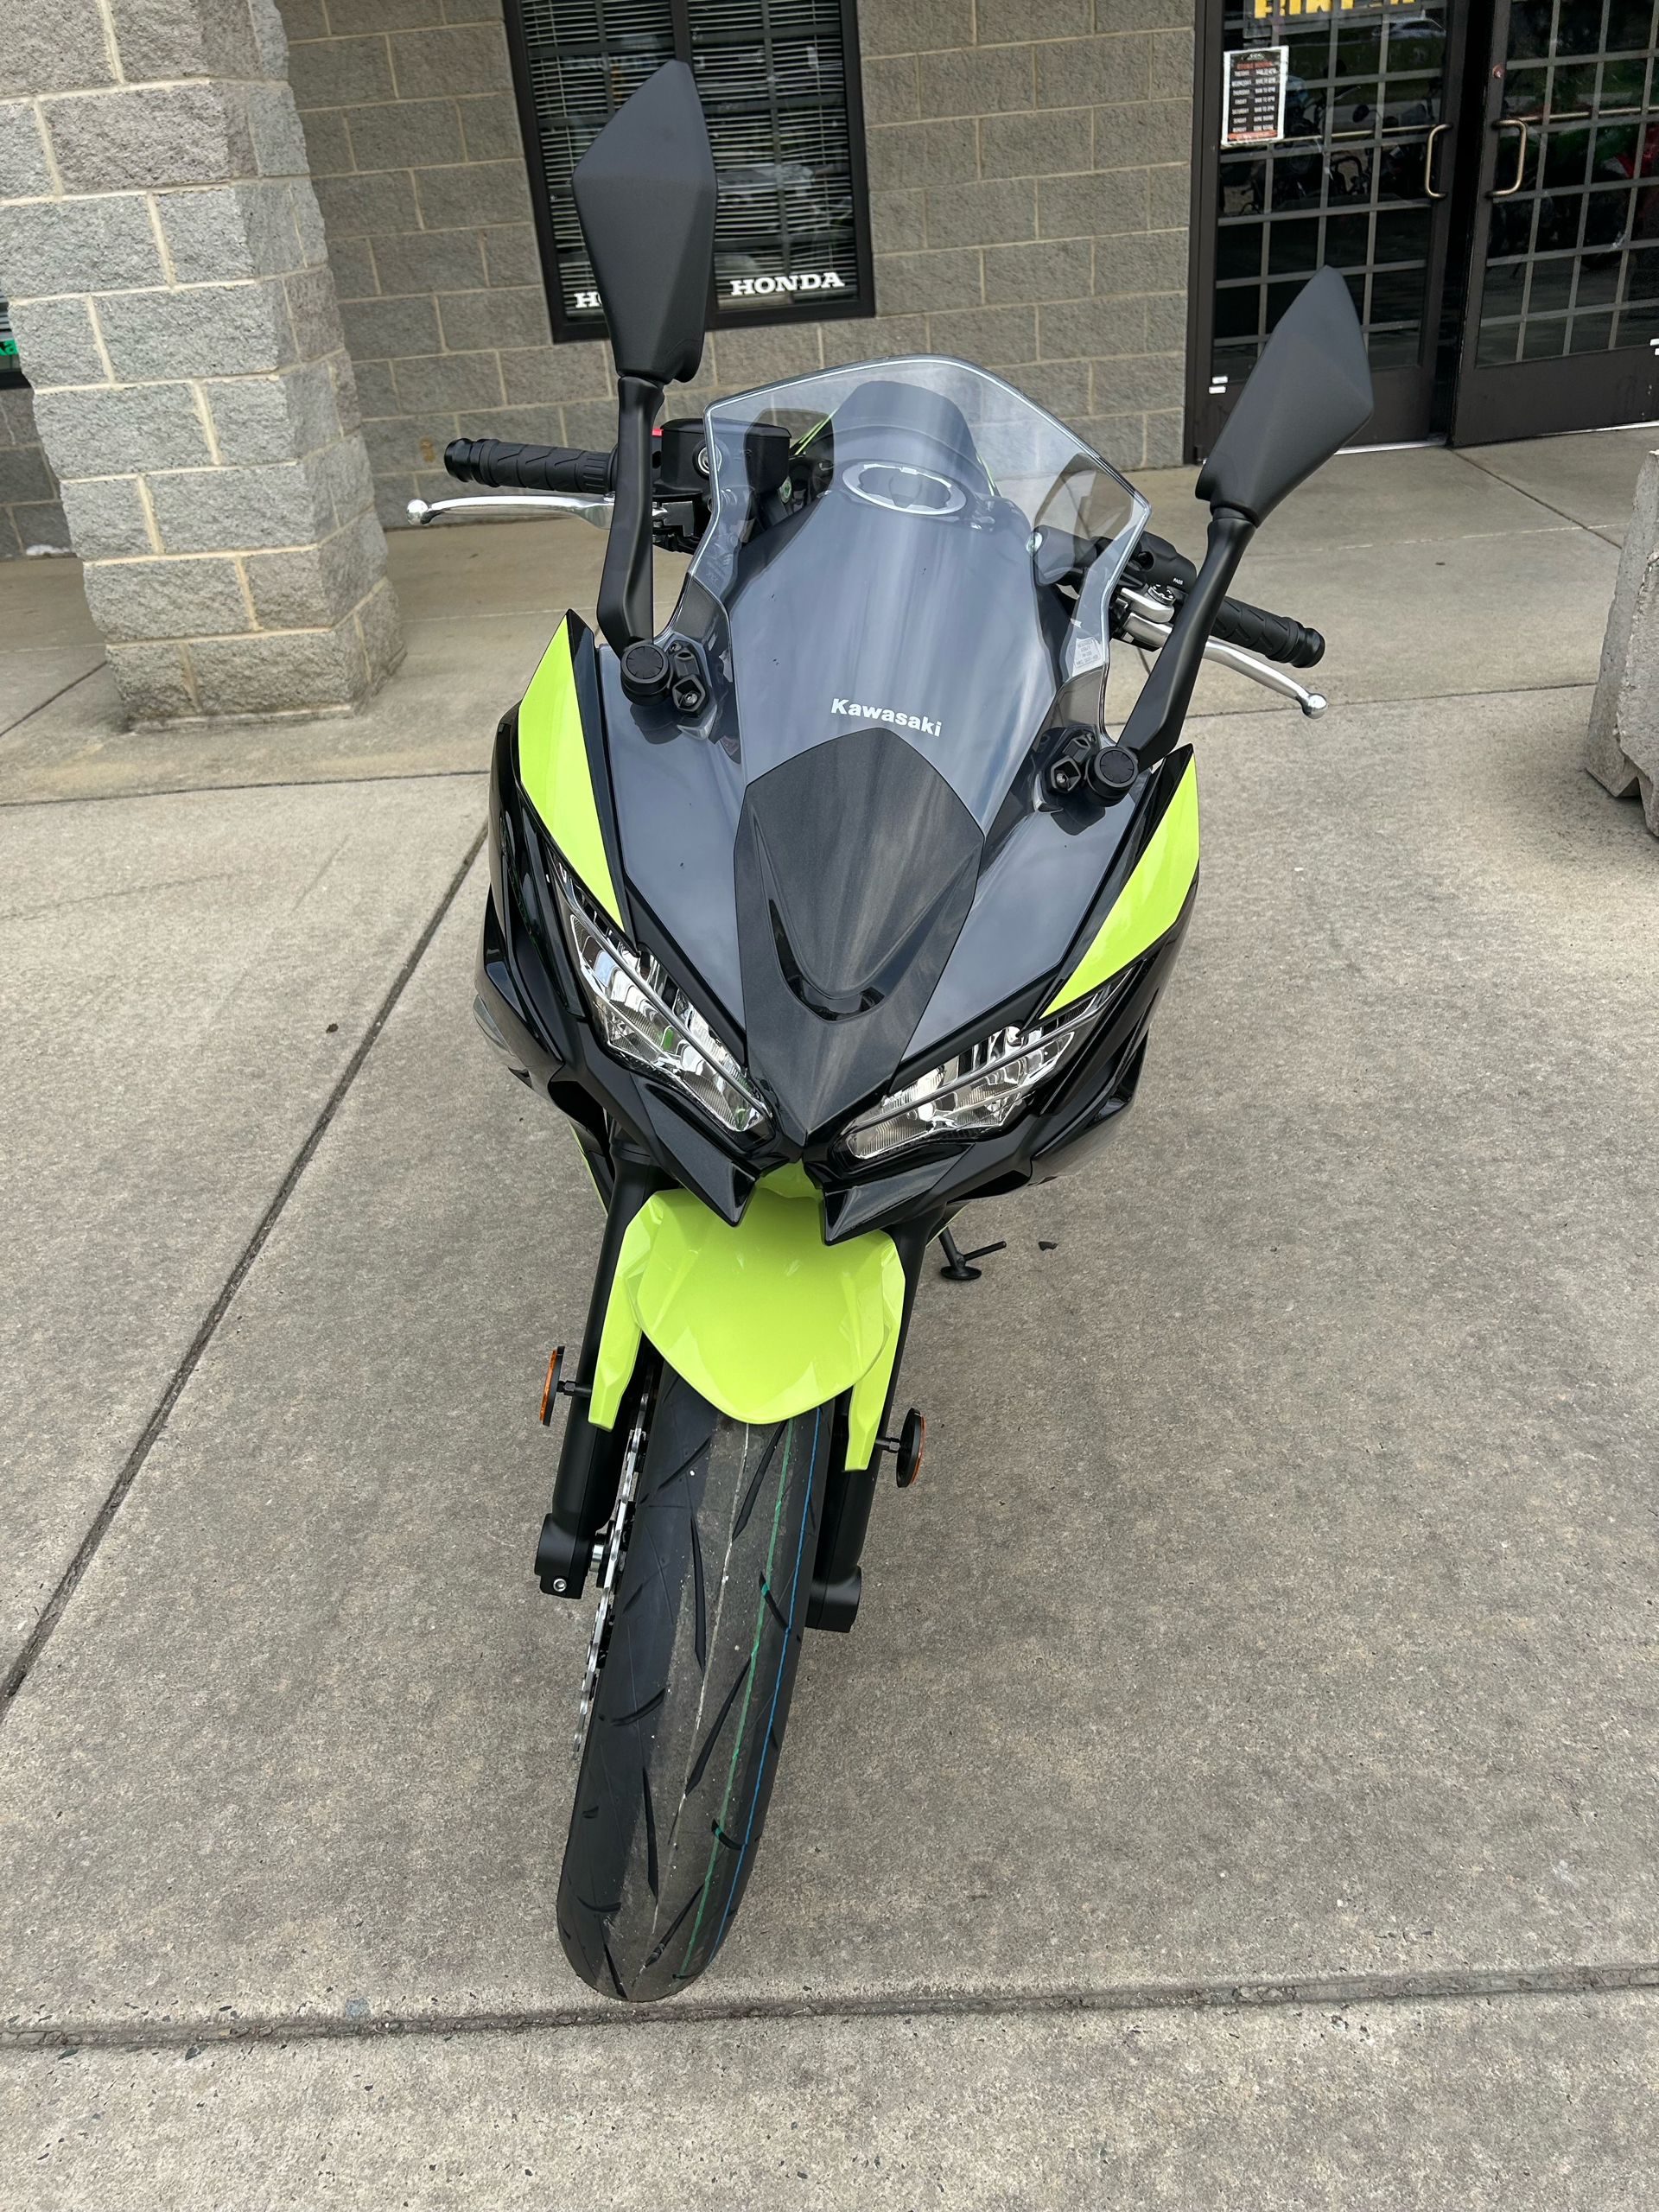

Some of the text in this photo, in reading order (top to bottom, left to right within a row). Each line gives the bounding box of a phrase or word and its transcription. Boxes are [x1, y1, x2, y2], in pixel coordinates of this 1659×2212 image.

[729, 271, 845, 296] HONDA
[574, 291, 603, 308] H
[831, 698, 942, 737] Kawasaki
